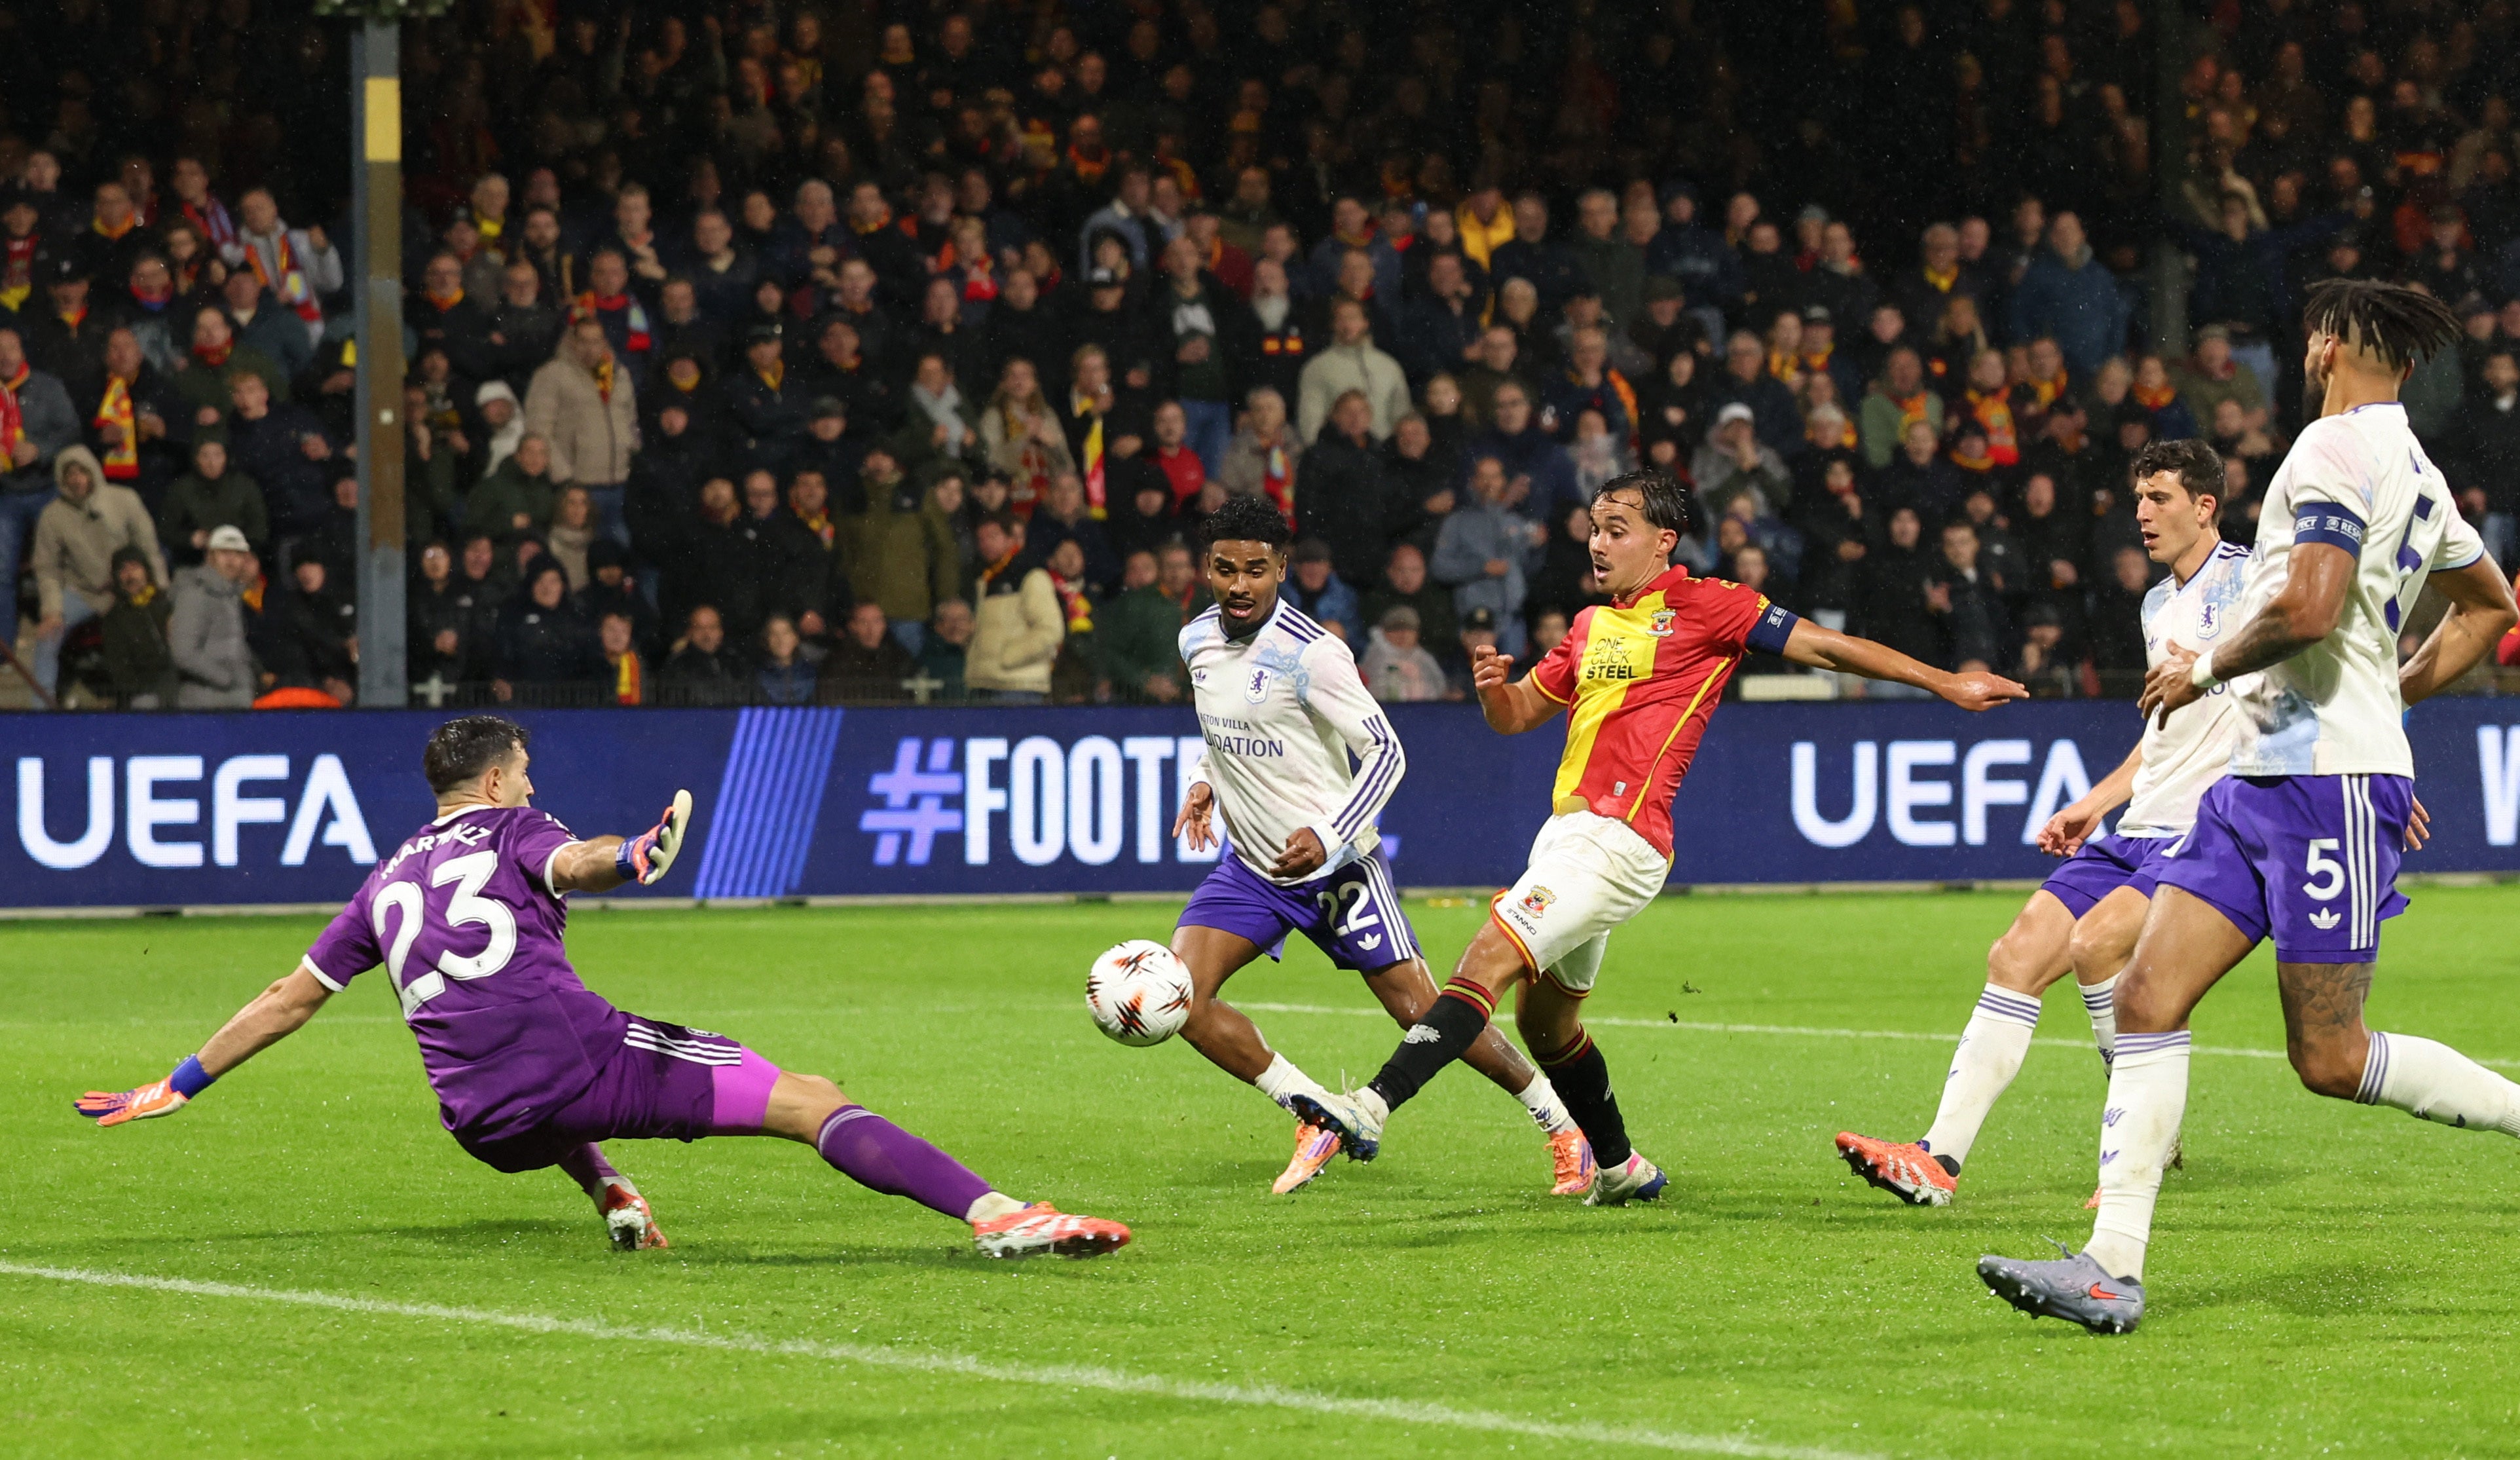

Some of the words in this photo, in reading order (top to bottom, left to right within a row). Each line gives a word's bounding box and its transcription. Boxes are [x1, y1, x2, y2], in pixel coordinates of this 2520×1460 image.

[1591, 650, 1632, 665] CLICK
[1595, 637, 1626, 651] ONE
[1586, 665, 1639, 679] STEEL
[1222, 718, 1251, 731] VILLA
[16, 754, 379, 870] UEFA
[1791, 739, 2110, 847] UEFA
[2302, 838, 2346, 901] 5
[1316, 881, 1380, 937] 22
[1506, 908, 1537, 935] STANNO
[372, 850, 517, 1020] 23
